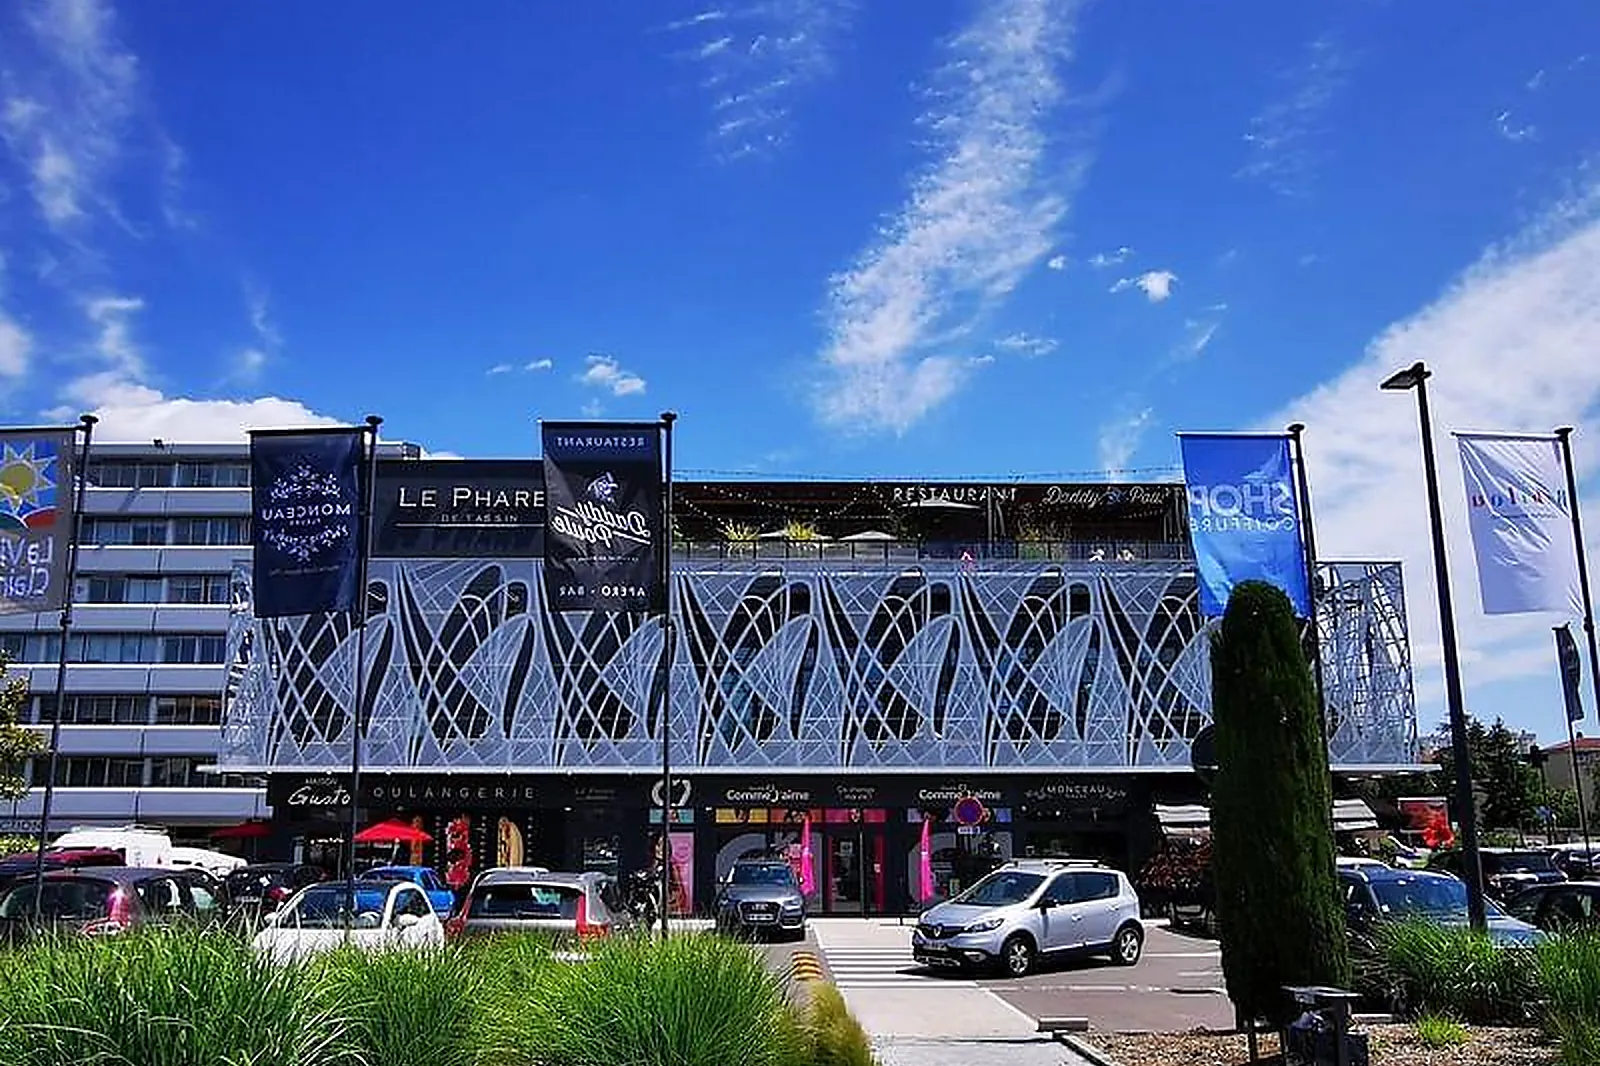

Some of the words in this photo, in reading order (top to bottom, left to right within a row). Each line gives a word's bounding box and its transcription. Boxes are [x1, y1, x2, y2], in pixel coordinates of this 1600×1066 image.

[400, 487, 437, 507] LE
[453, 487, 544, 507] PHARE
[288, 785, 350, 805] Gusto
[726, 789, 770, 801] Comme
